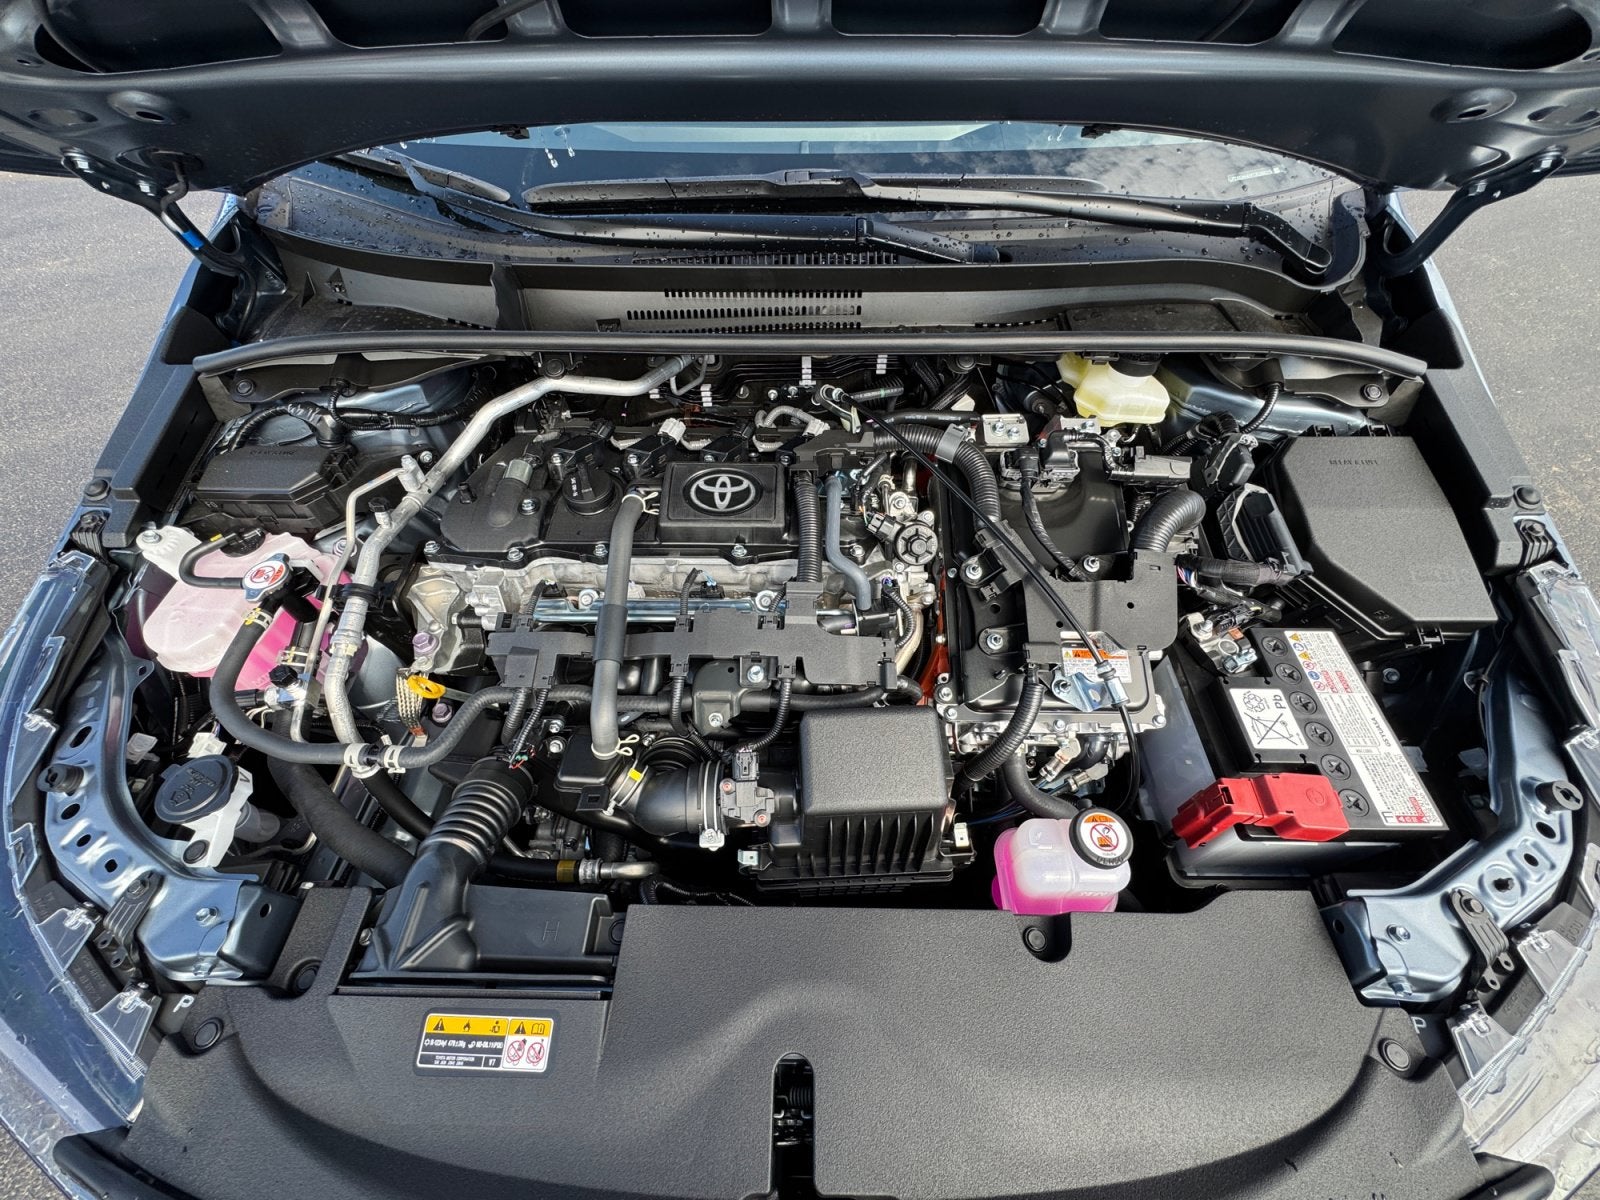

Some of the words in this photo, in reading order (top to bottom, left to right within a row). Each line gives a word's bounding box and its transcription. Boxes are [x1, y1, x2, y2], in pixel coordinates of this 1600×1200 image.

[1272, 694, 1287, 709] Pb
[172, 994, 195, 1013] P
[1410, 1016, 1427, 1034] P
